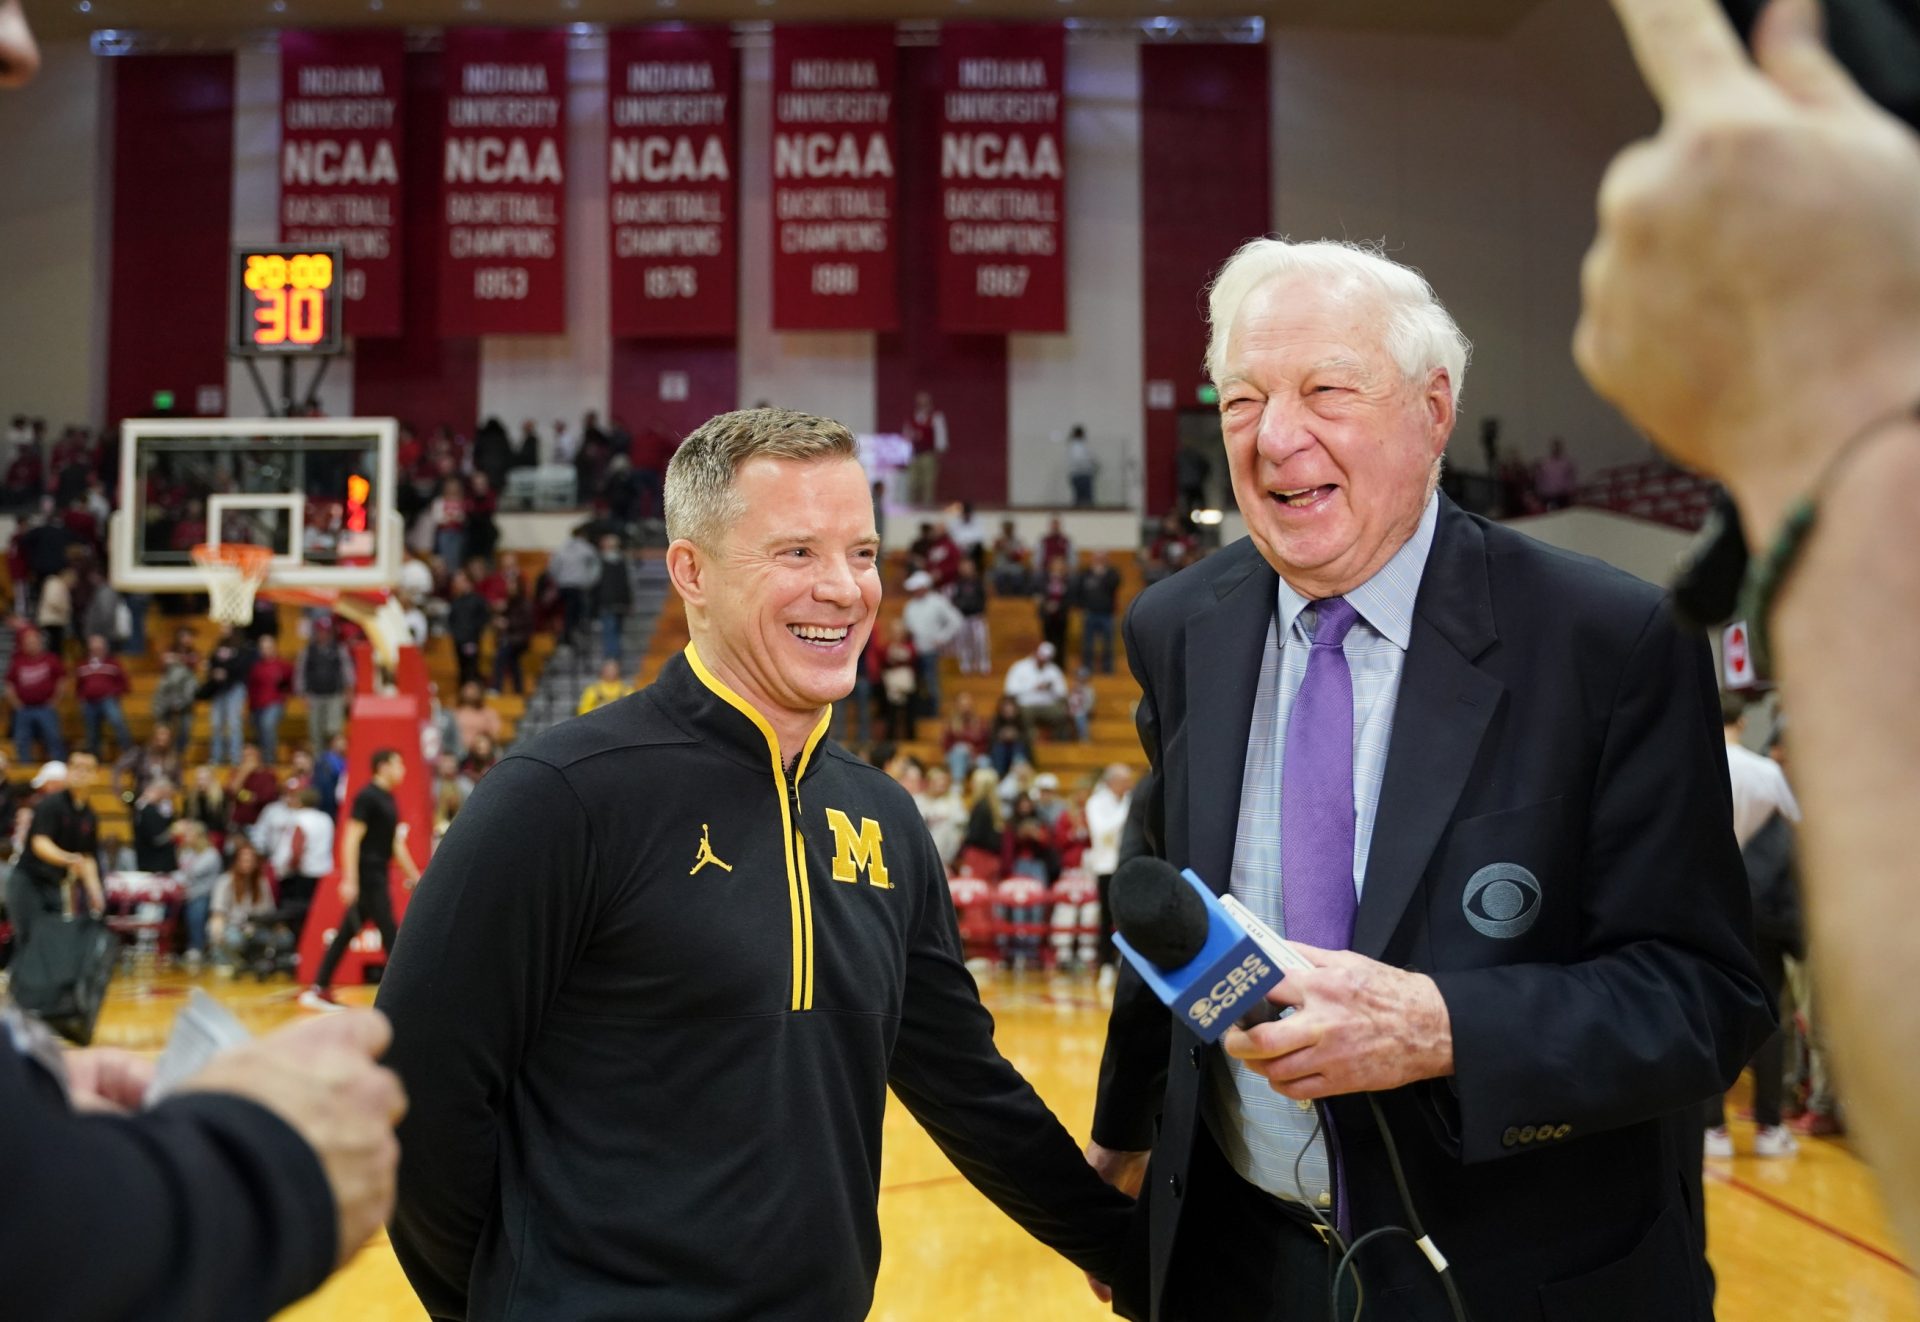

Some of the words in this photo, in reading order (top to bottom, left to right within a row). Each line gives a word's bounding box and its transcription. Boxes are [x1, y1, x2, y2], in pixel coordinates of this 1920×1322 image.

[300, 66, 383, 95] INDIANA
[463, 63, 548, 93] INDIANA
[627, 63, 714, 93] INDIANA
[791, 60, 878, 89] INDIANA
[959, 59, 1046, 89] INDIANA
[286, 99, 395, 130] UNIVERSITY
[449, 97, 559, 127] UNIVERSITY
[613, 95, 726, 126] UNIVERSITY
[777, 92, 891, 123] UNIVERSITY
[945, 93, 1058, 122] UNIVERSITY
[284, 140, 397, 185] NCAA
[445, 138, 562, 183] NCAA
[611, 136, 728, 182] NCAA
[775, 133, 893, 178] NCAA
[942, 133, 1062, 179] NCAA
[285, 195, 392, 226] BASKETBALL
[447, 193, 556, 224] BASKETBALL
[612, 191, 723, 224] BASKETBALL
[776, 187, 889, 219] BASKETBALL
[945, 189, 1057, 221] BASKETBALL
[450, 226, 555, 258] CHAMPIONS
[616, 225, 721, 257] CHAMPIONS
[781, 221, 886, 253] CHAMPIONS
[949, 223, 1056, 255] CHAMPIONS
[244, 254, 333, 290] 20:00
[253, 288, 324, 344] 30
[826, 808, 889, 889] M
[1210, 953, 1262, 1001] CBS
[1199, 964, 1270, 1029] SPORTS
